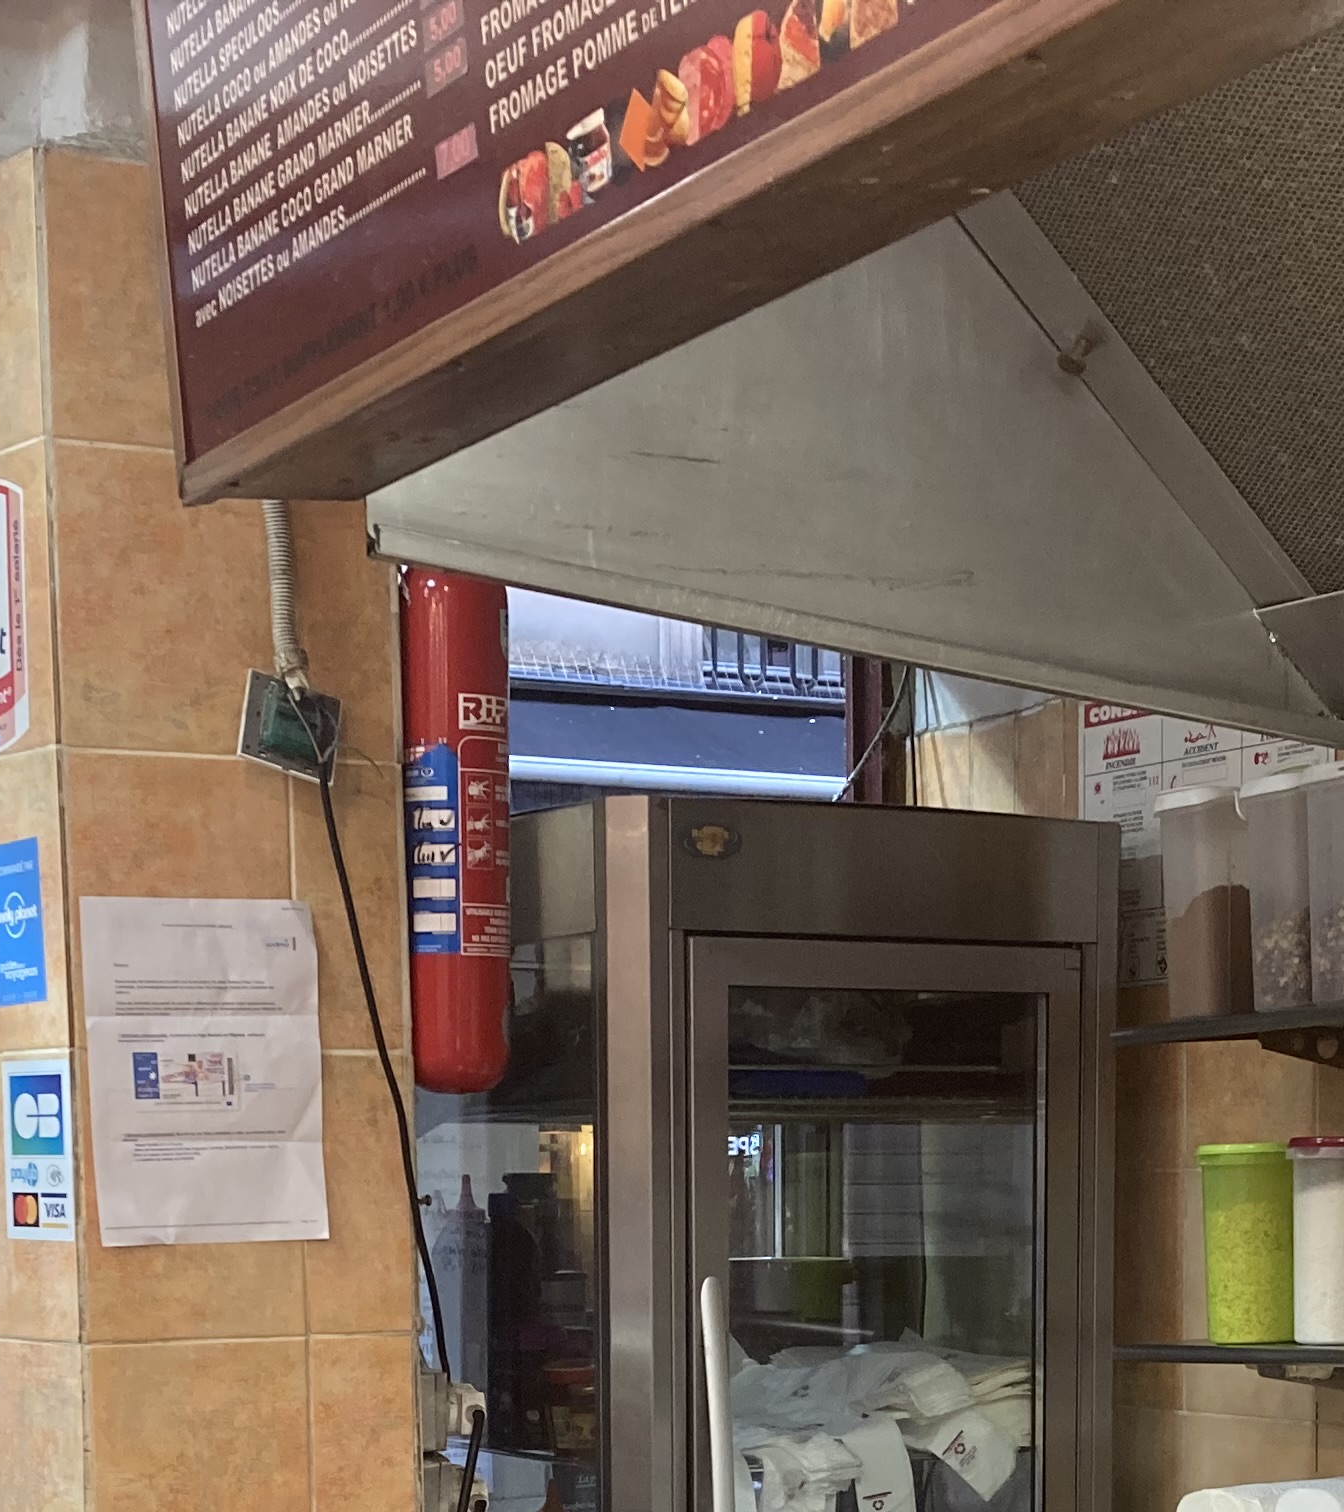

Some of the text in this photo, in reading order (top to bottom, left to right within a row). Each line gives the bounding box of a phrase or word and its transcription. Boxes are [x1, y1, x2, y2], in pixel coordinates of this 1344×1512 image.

[170, 17, 214, 76] NUTELLA
[173, 56, 218, 112] NUTELLA
[176, 93, 222, 148] NUTELLA
[223, 67, 251, 109] COCO
[254, 59, 267, 84] ou
[269, 7, 321, 73] AMANDES
[485, 35, 527, 89] OEUF
[489, 7, 659, 134] FROMAGE POMME DE
[180, 130, 226, 185] NUTELLA
[226, 94, 269, 148] BANANE
[269, 69, 298, 112] NOIX
[298, 55, 316, 89] DE
[184, 19, 418, 220] NUTELLA BANANE AMANDES ou NOISETTES
[187, 205, 233, 256] NUTELLA
[232, 170, 277, 222] BANANE
[277, 142, 316, 189] GRAND
[190, 114, 415, 293] NUTELLA BANANE COCO GRAND MARNIER
[195, 299, 218, 328] avec
[218, 253, 275, 312] NOISETTES
[276, 248, 290, 272] ou
[1183, 742, 1219, 757] ACCIDENT
[43, 1202, 67, 1219] VISA
